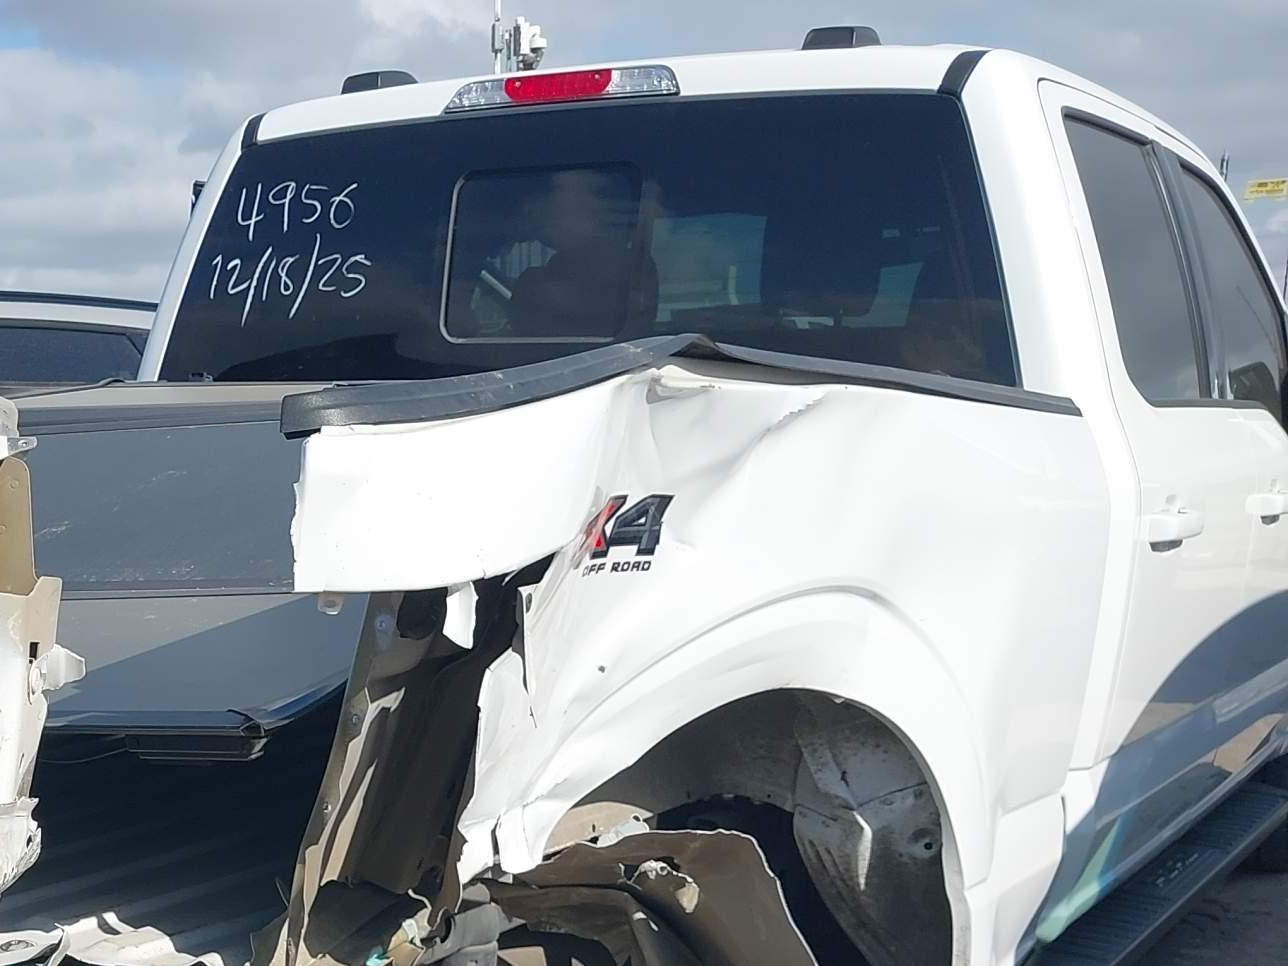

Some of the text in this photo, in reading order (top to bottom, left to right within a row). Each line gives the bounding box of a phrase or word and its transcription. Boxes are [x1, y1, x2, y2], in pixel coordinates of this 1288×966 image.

[237, 181, 359, 241] 4956
[209, 233, 372, 327] 12/18/25
[582, 560, 652, 577] OFF ROAD
